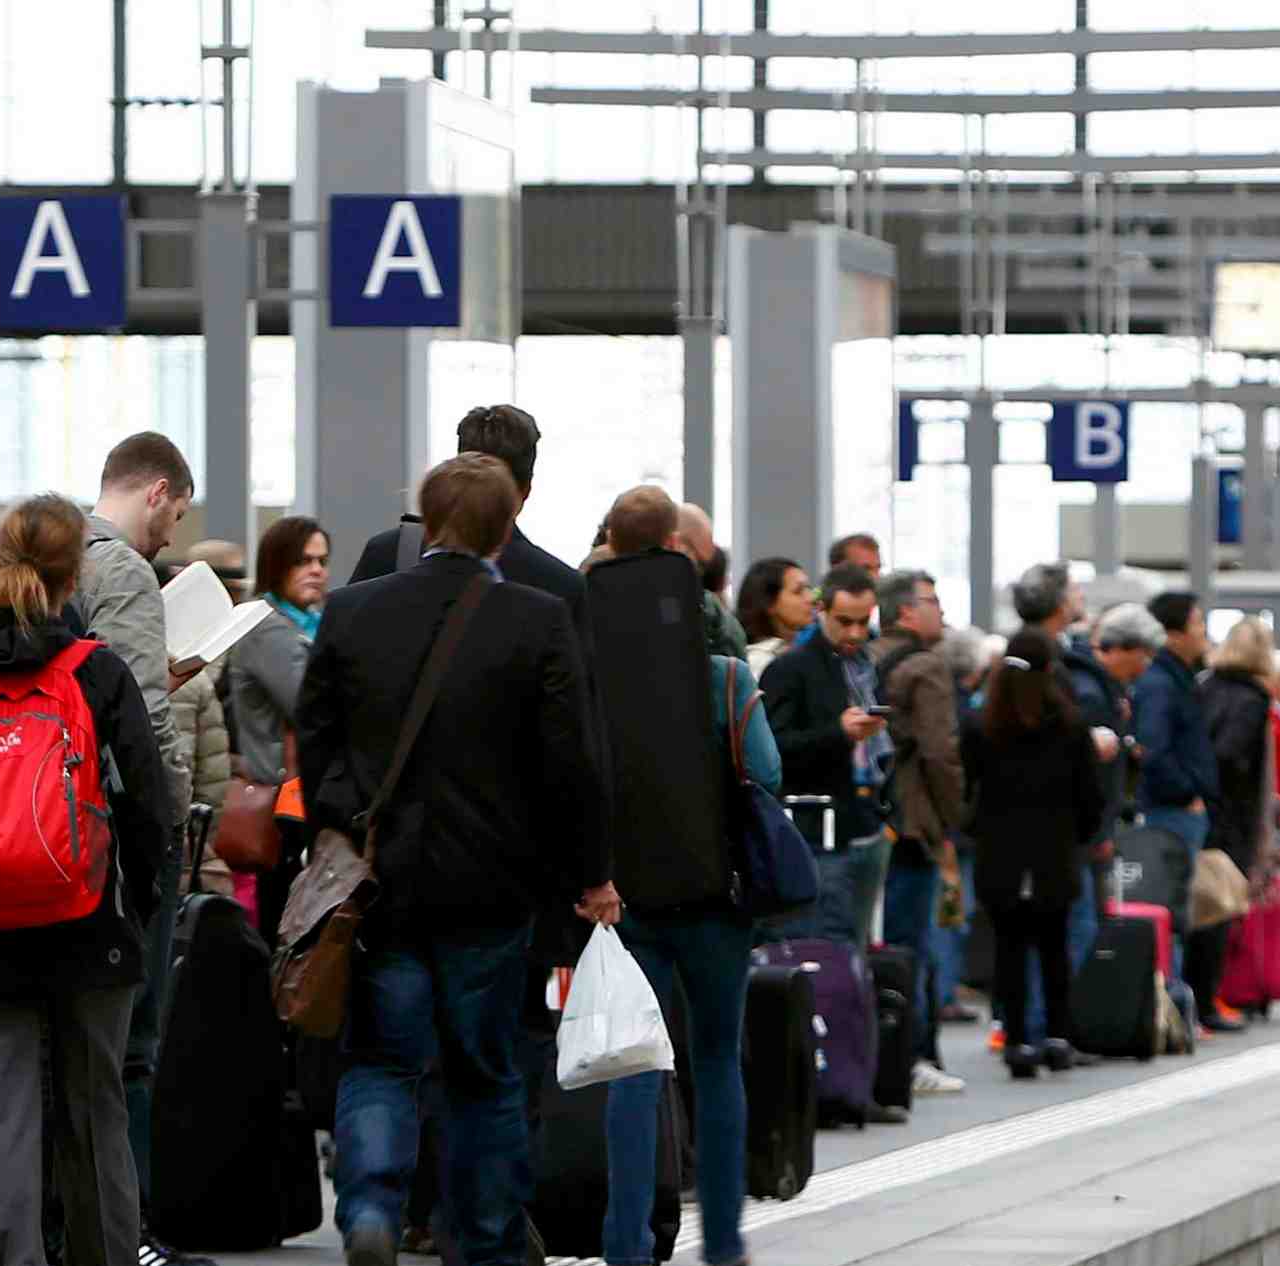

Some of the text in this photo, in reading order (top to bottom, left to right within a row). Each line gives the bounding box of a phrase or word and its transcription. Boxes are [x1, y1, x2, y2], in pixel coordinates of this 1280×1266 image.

[10, 200, 91, 298] A
[362, 200, 444, 298] A
[1076, 402, 1124, 468] B
